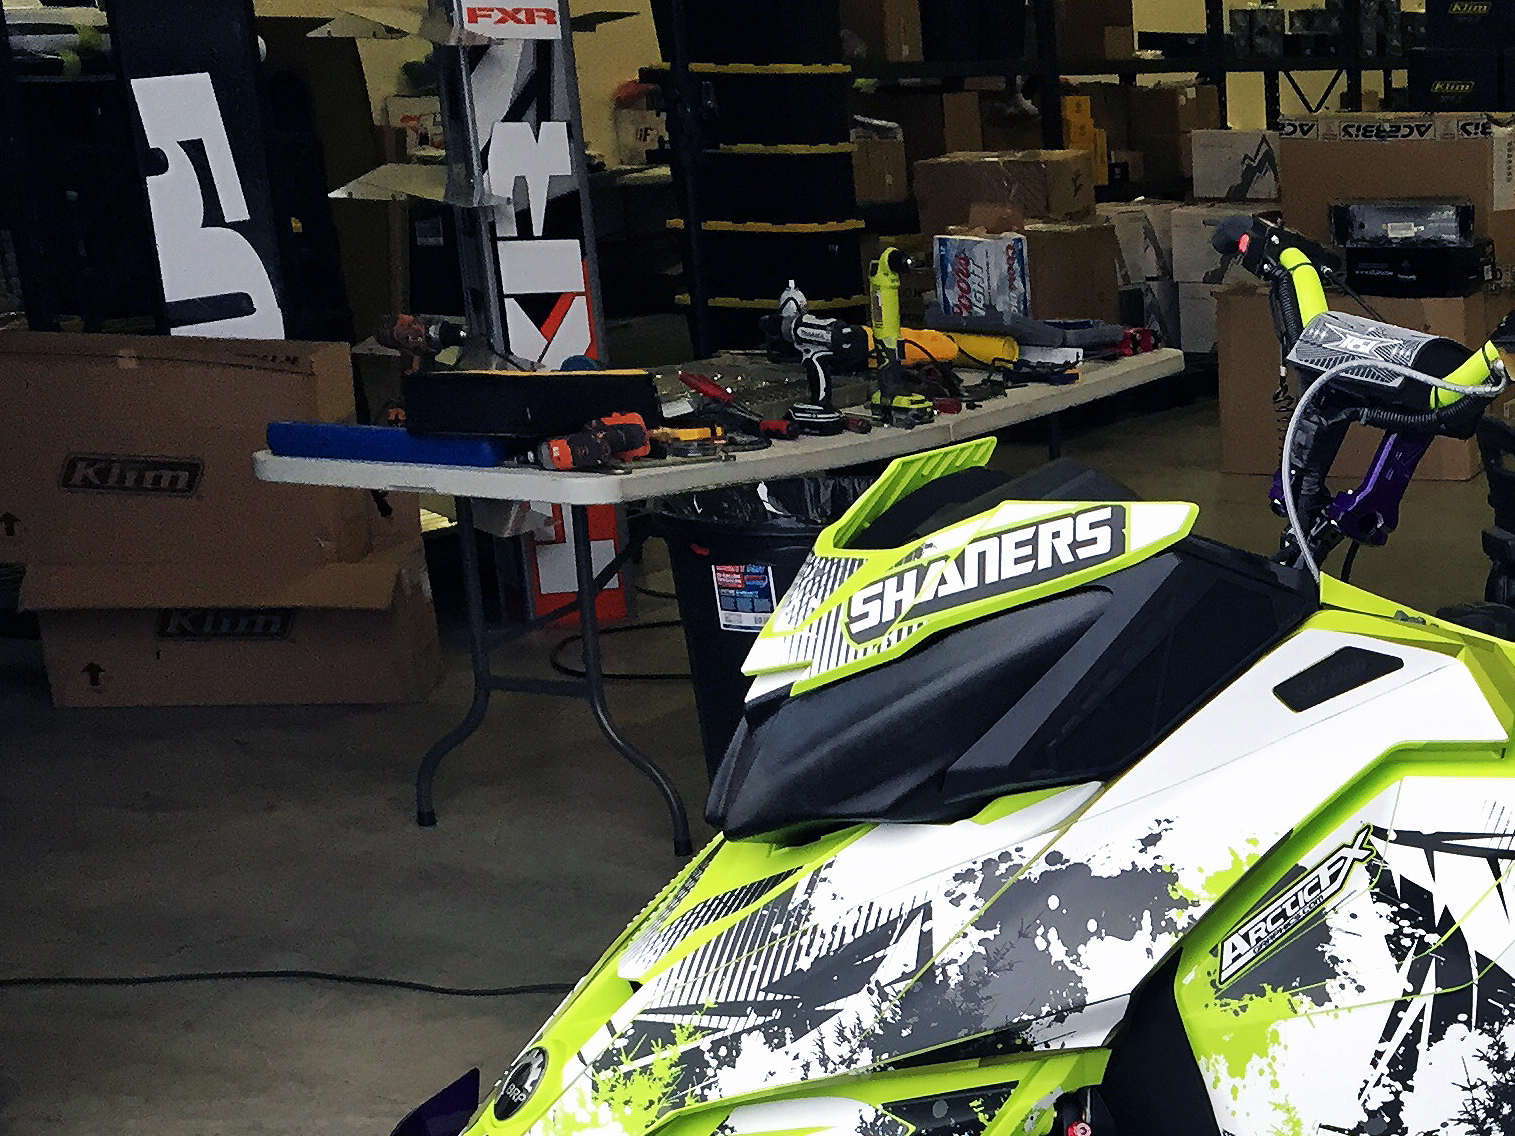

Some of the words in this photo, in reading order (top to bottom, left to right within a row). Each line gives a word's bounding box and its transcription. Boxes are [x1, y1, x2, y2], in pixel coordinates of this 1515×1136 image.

[466, 7, 558, 25] FXR
[1432, 81, 1473, 92] Klim
[68, 460, 191, 489] Klim
[848, 507, 1115, 636] SHANERS
[1222, 827, 1371, 973] ARCTICFX
[505, 1083, 527, 1103] BRP
